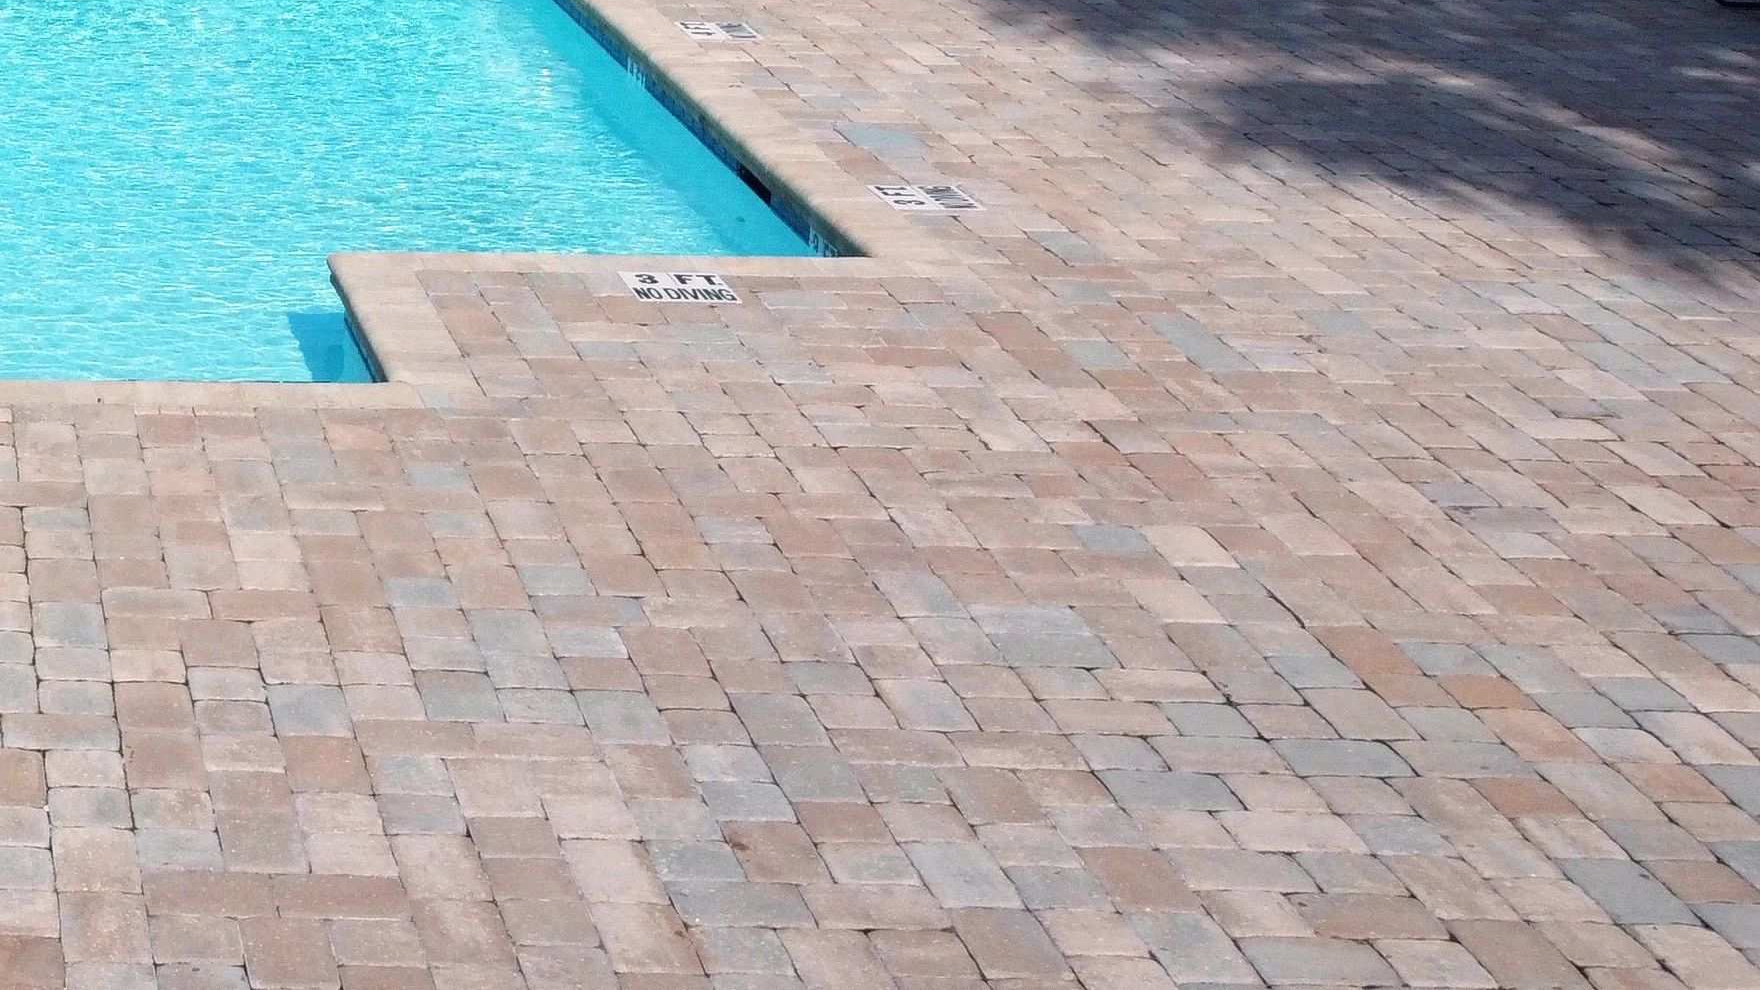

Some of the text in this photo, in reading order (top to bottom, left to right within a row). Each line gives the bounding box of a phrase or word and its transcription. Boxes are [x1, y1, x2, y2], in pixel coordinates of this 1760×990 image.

[635, 273, 659, 285] 3
[633, 287, 738, 301] NO DIVING
